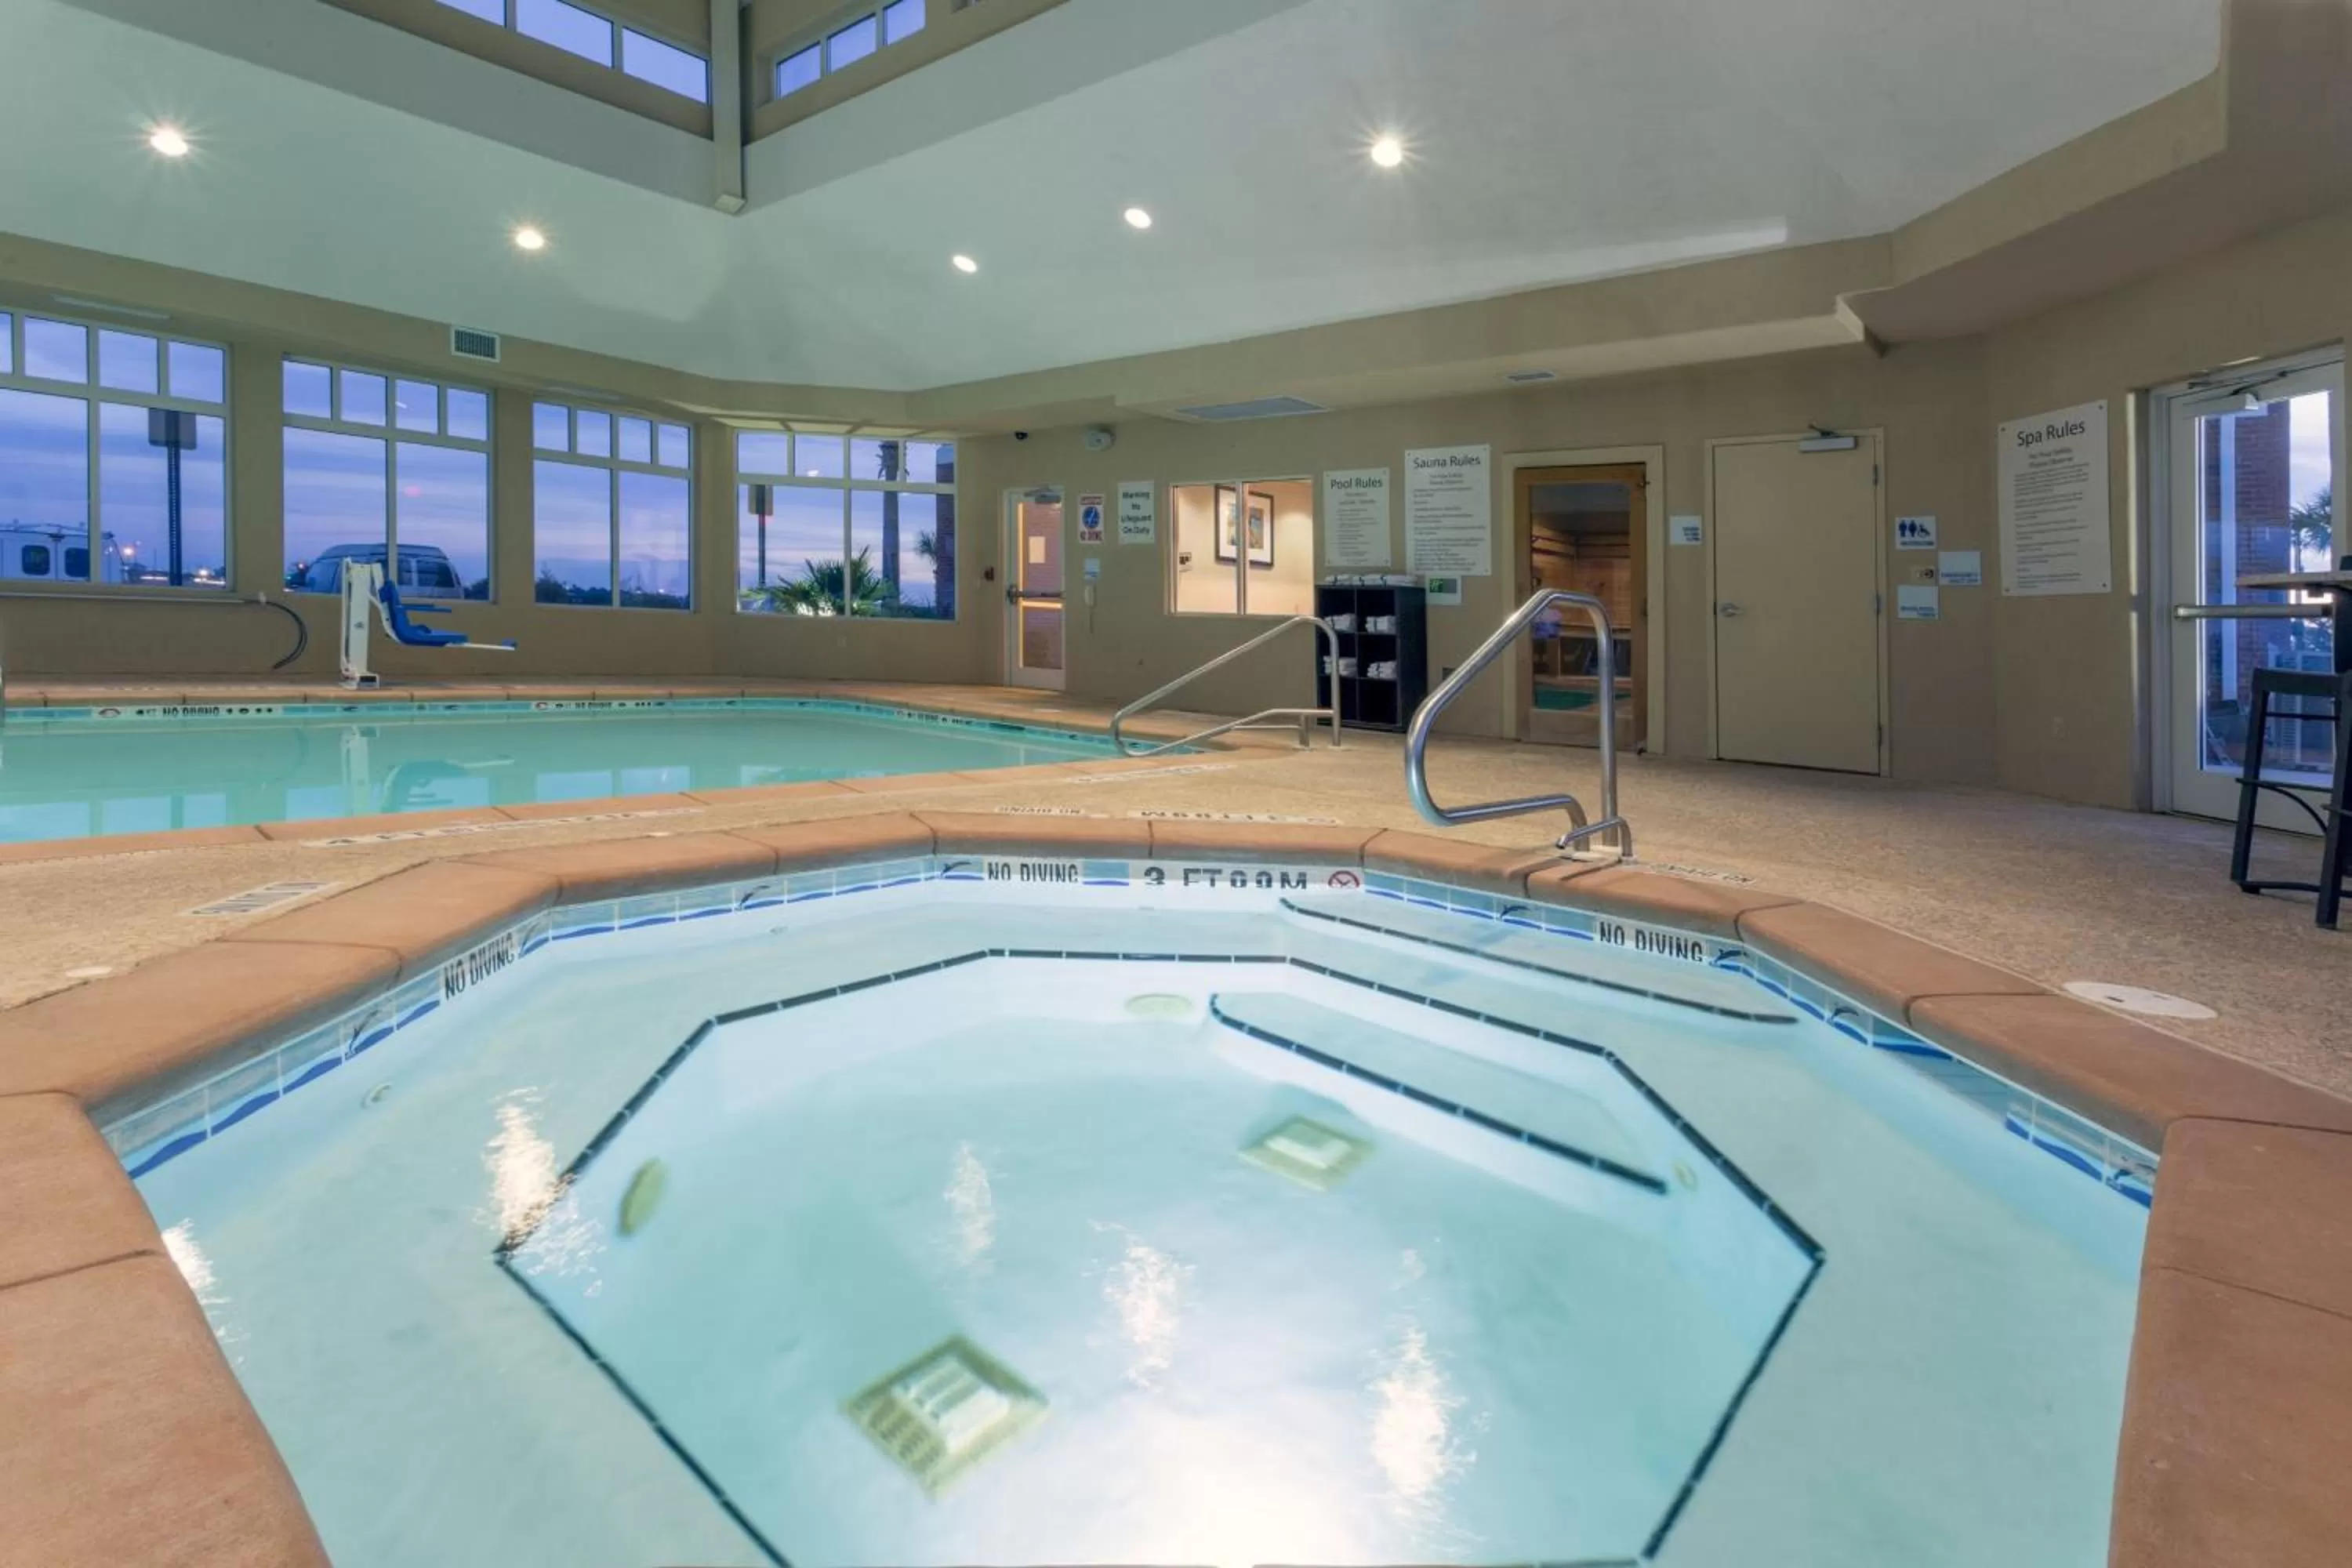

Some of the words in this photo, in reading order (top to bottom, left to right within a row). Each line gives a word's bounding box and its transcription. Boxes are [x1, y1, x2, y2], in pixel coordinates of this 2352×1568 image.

[2016, 430, 2043, 448] Spa
[2045, 420, 2085, 440] Rules
[1414, 457, 1447, 469] Sauna
[1450, 452, 1482, 467] Rules
[1330, 477, 1352, 490] Pool
[1356, 476, 1384, 488] Rules
[988, 862, 1011, 880] NO
[1019, 863, 1079, 883] DIVING
[1144, 866, 1165, 885] 3
[1599, 921, 1625, 946] NO
[1635, 928, 1703, 962] DIVING
[444, 959, 466, 1000] NO
[469, 932, 515, 985] DIVING
